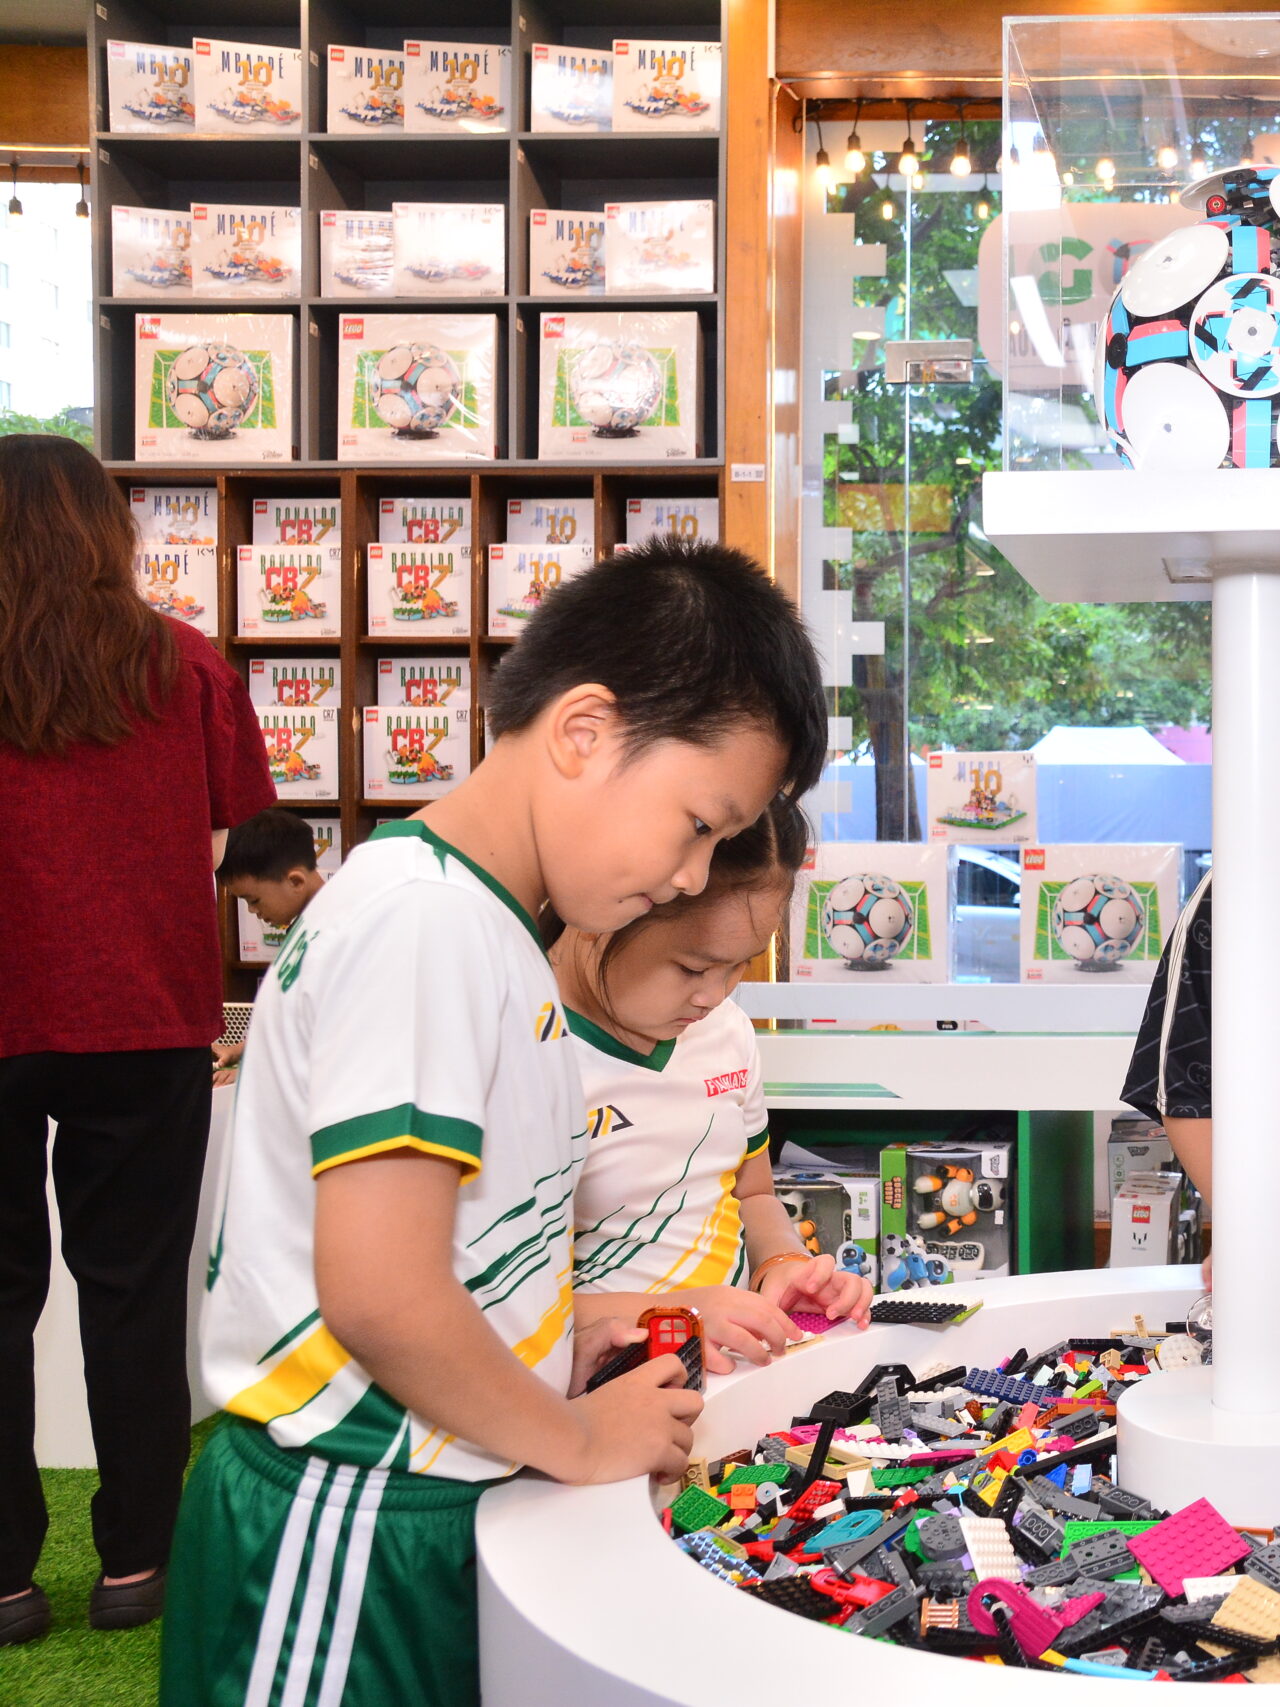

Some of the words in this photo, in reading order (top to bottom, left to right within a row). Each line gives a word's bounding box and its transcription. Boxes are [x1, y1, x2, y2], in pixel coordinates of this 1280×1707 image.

[344, 325, 362, 333] LEGO
[273, 667, 334, 688] RONALDO
[401, 666, 461, 687] RONALDO
[257, 715, 316, 736] ONALDO
[387, 716, 448, 736] RONALDO
[970, 769, 1002, 796] 10
[1026, 855, 1043, 864] LEGO
[1133, 1210, 1149, 1218] LEGO
